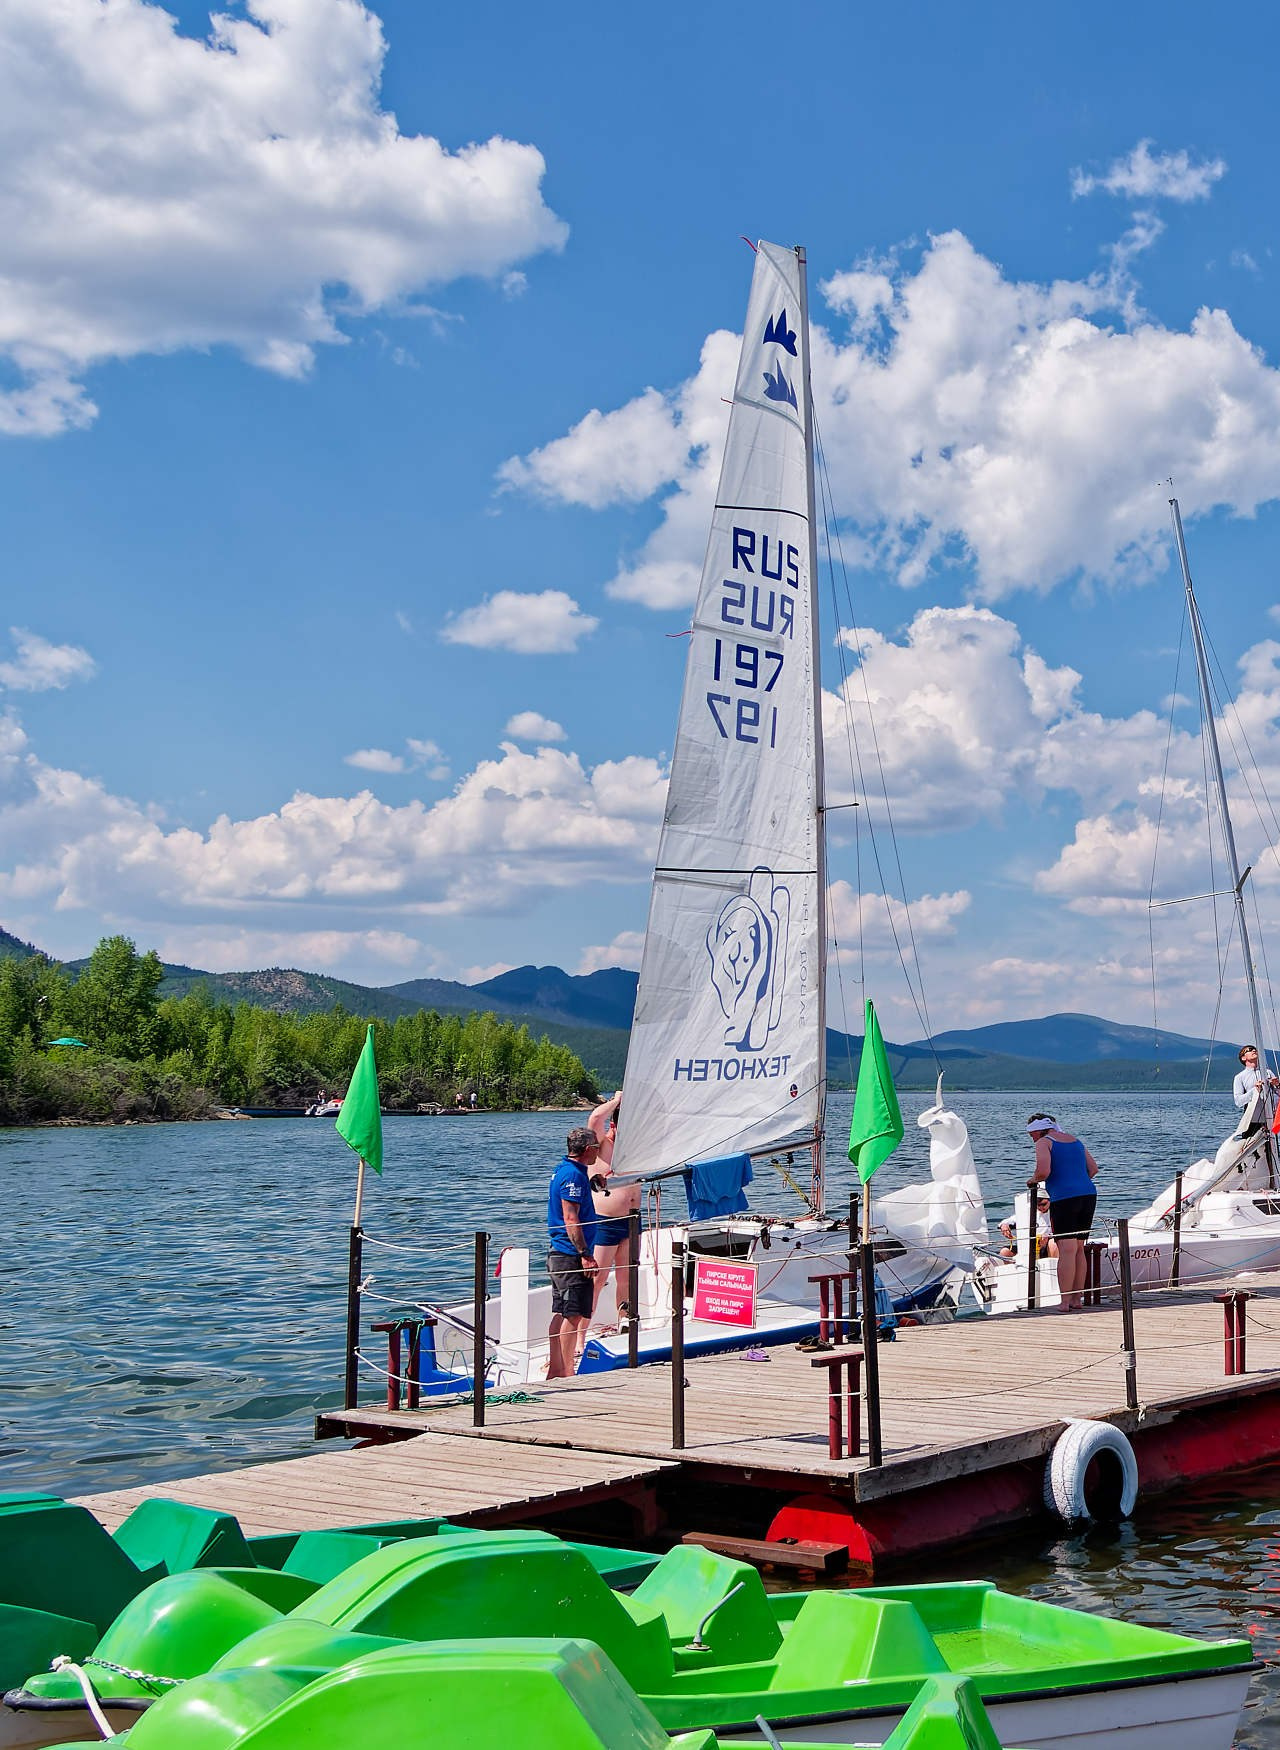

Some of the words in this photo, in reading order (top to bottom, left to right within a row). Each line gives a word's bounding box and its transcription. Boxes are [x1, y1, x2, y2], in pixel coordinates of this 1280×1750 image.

[732, 526, 799, 590] RUS
[713, 638, 785, 692] 197
[705, 1297, 720, 1305] ВХОД
[730, 1300, 744, 1308] ПИРС
